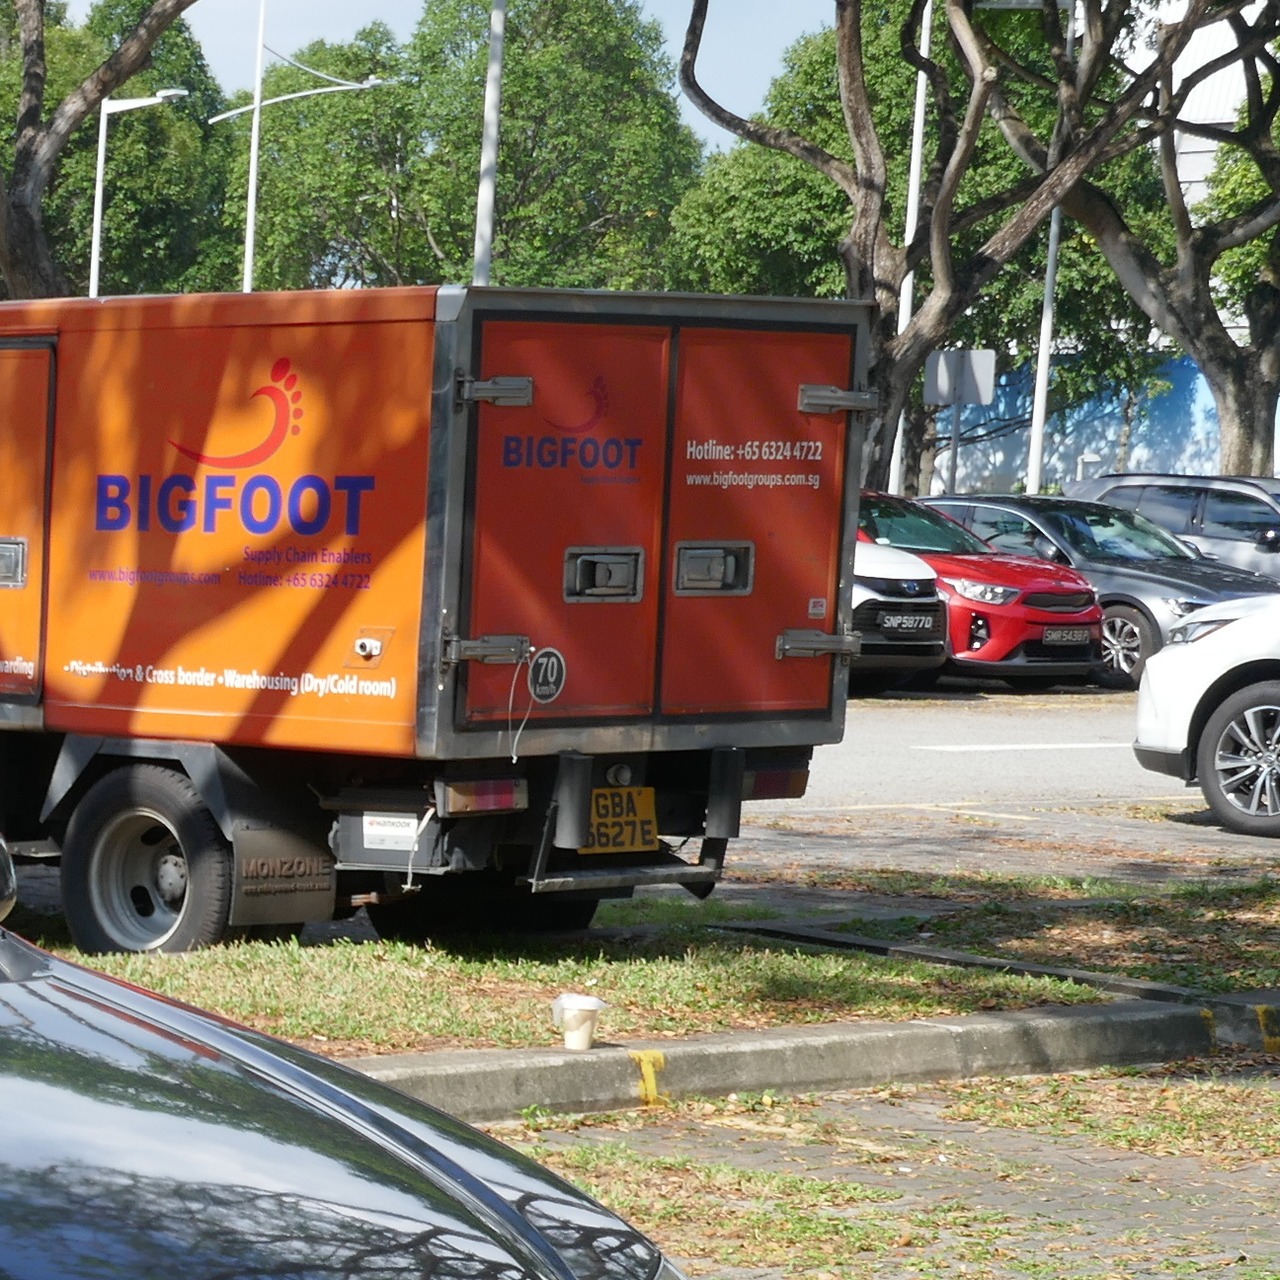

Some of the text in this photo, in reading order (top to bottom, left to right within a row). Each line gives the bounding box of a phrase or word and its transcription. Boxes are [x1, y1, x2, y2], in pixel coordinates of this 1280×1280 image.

[503, 436, 643, 469] BIGFOOT
[686, 440, 822, 460] Hotline: +65 6324 4722
[686, 471, 820, 489] www.bigfootgroups.com.sg
[95, 474, 376, 536] BIGFOOT
[243, 546, 372, 565] Supply Chain Enablers
[239, 573, 371, 590] Hotline: +65 6324 4722
[538, 656, 557, 683] 70
[135, 666, 144, 682] &
[145, 666, 175, 685] Cross
[177, 666, 216, 687] border
[224, 669, 299, 695] Warehousing
[300, 673, 358, 697] (Dry/Cold
[358, 677, 397, 699] room)
[595, 791, 637, 818] GBA
[242, 857, 331, 879] MONZONE
